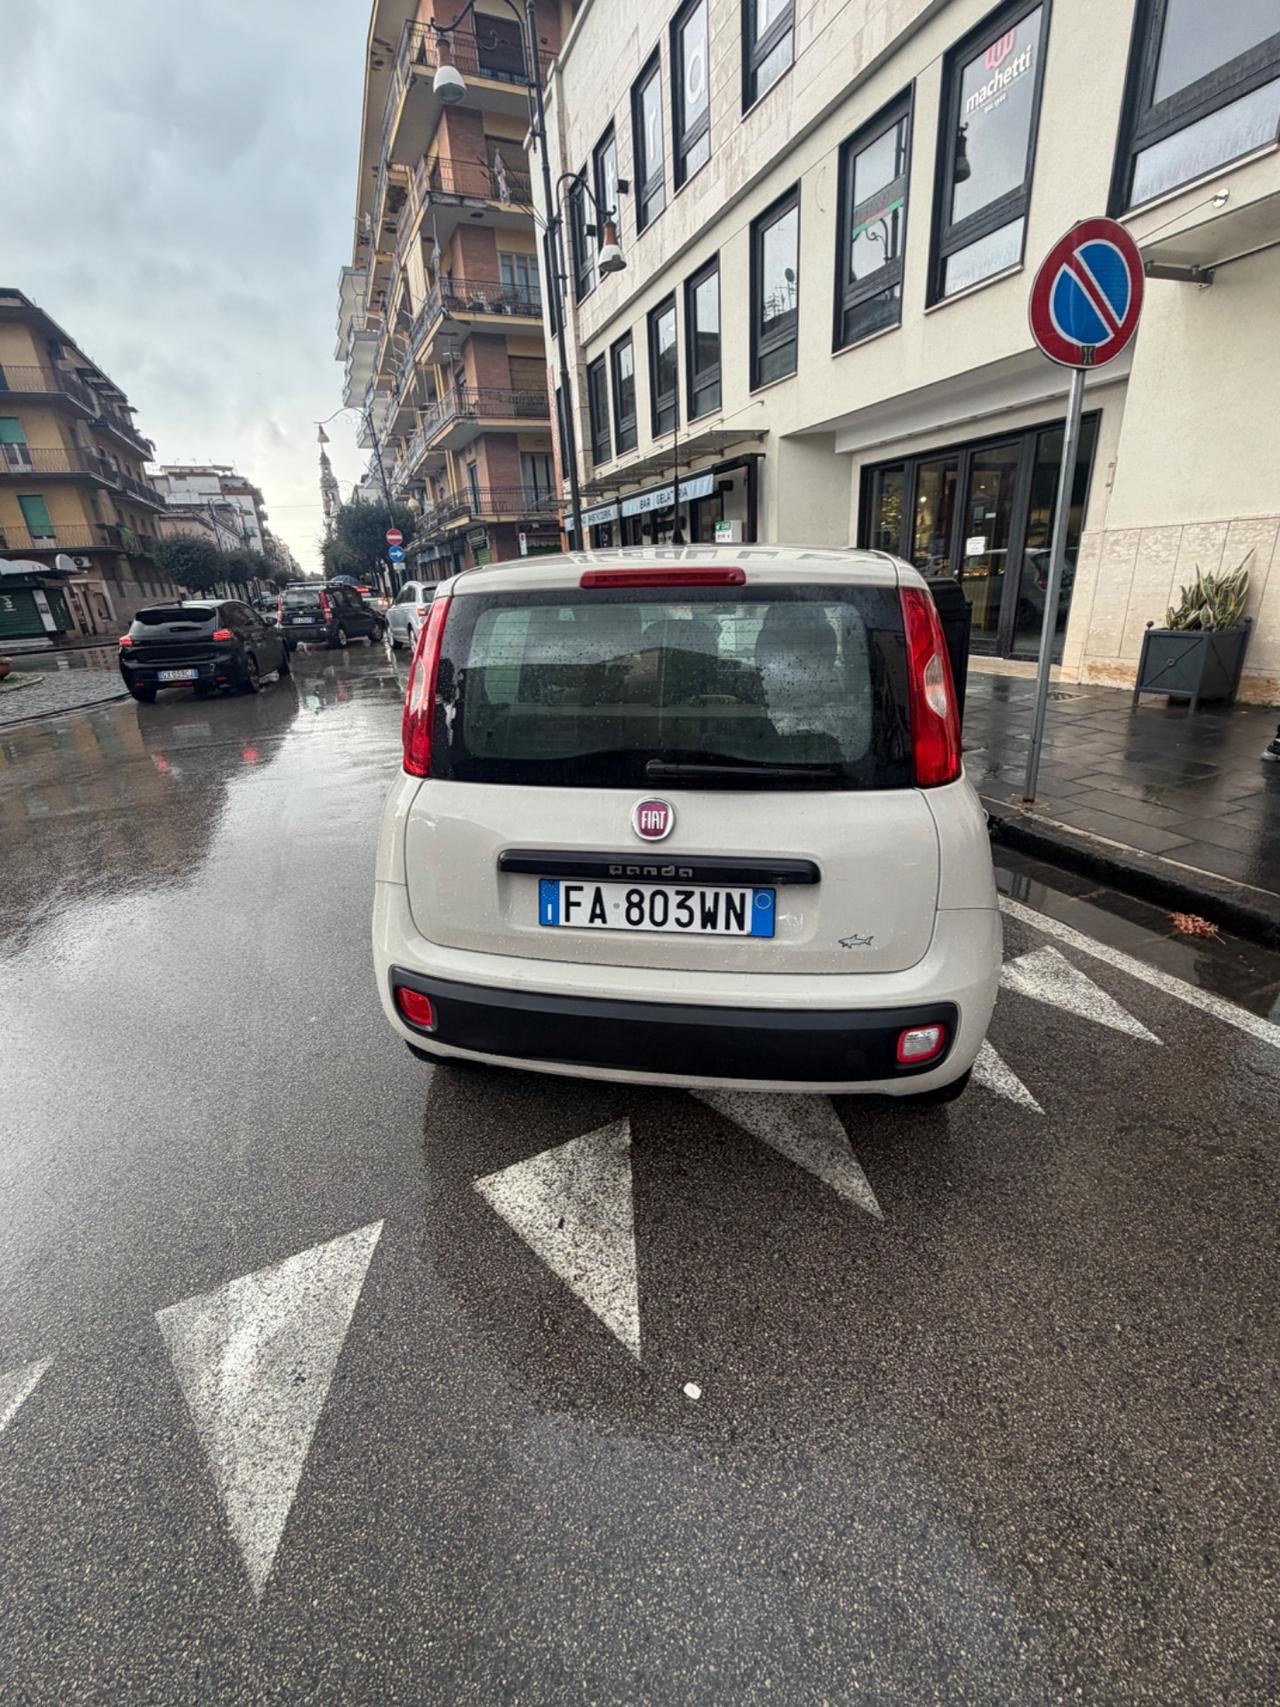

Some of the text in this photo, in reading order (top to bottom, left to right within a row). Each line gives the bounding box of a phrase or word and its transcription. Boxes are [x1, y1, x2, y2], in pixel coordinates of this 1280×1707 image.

[966, 44, 1032, 113] machetti
[639, 487, 689, 510] BAR GELATRIA
[641, 810, 667, 830] FIAT
[608, 864, 693, 878] panda
